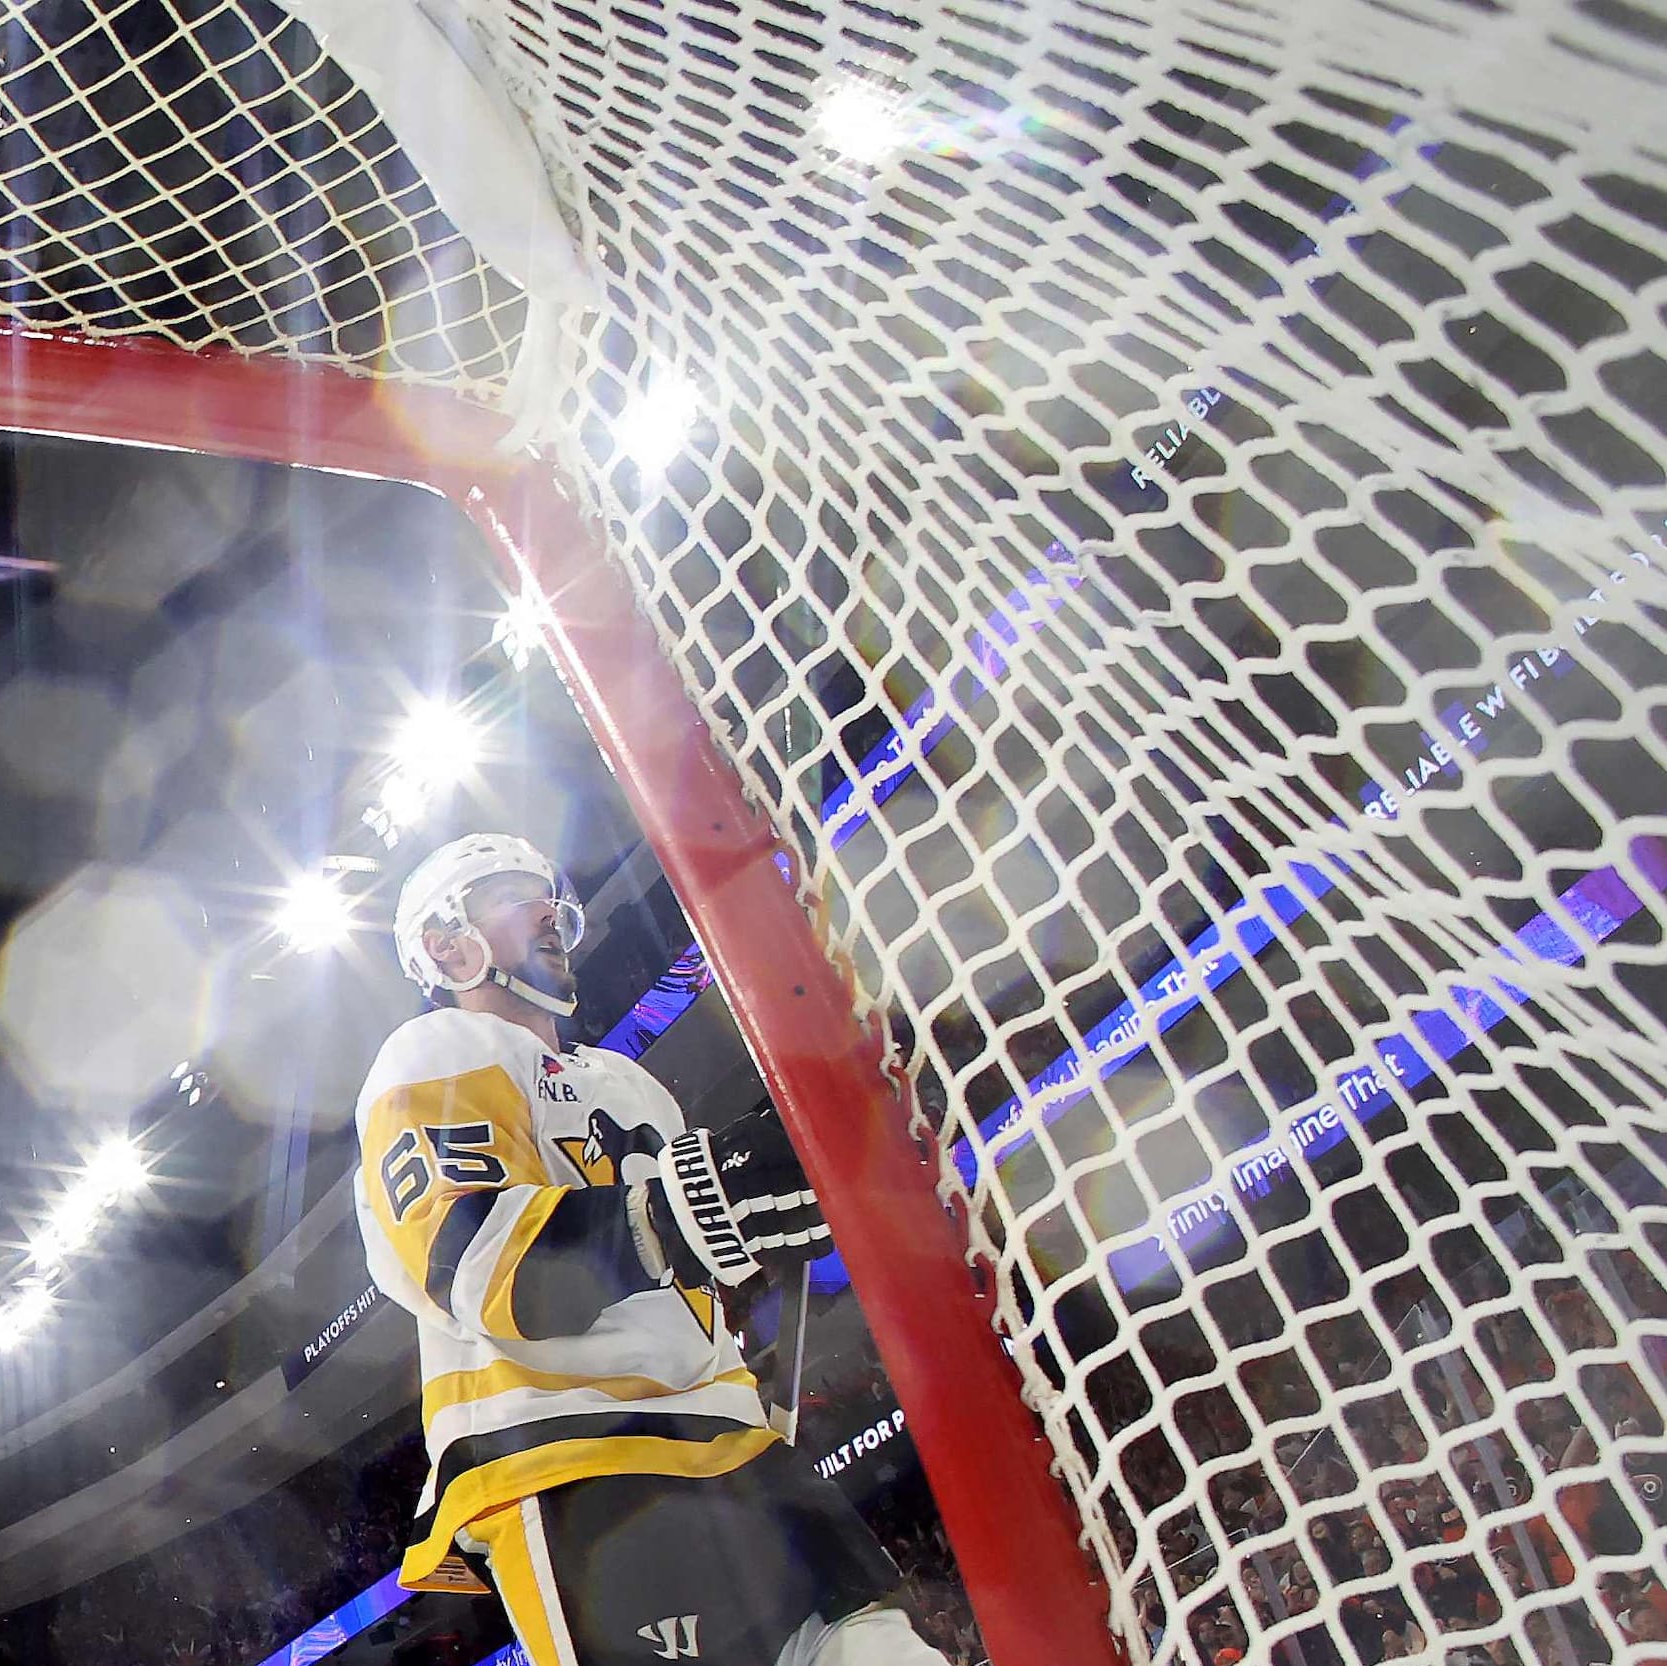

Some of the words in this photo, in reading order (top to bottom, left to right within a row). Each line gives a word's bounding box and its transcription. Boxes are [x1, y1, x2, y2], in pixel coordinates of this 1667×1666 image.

[379, 1120, 511, 1225] 65
[302, 1306, 357, 1364] PLAYOFFS
[851, 1419, 893, 1458] FOR
